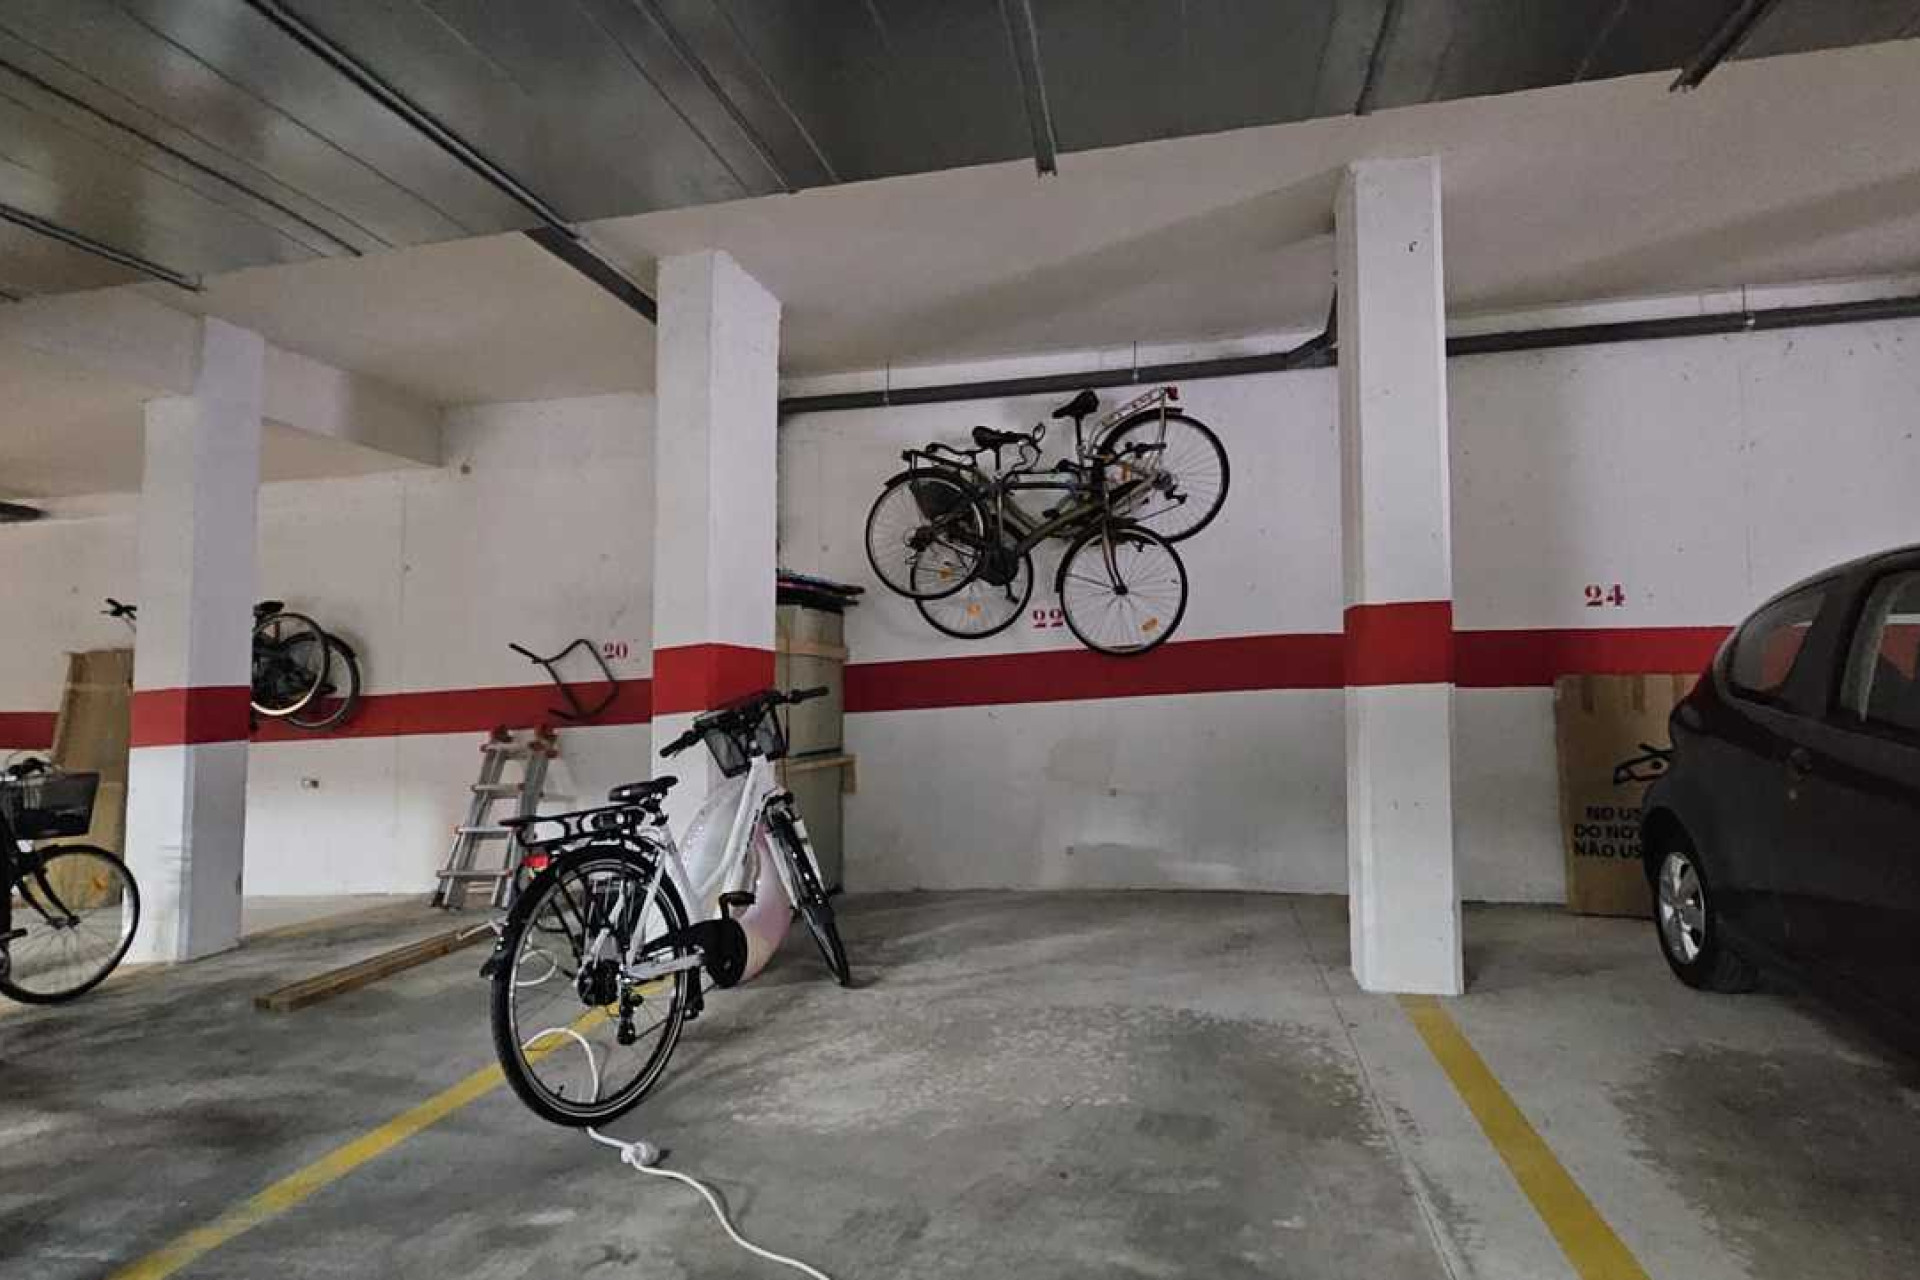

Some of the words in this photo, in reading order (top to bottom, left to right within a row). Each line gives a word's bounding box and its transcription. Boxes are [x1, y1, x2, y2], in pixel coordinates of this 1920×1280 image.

[1584, 583, 1625, 606] 24
[1033, 609, 1064, 628] 22
[603, 642, 628, 659] 20
[1586, 805, 1615, 820] NO
[1573, 824, 1601, 839] DO
